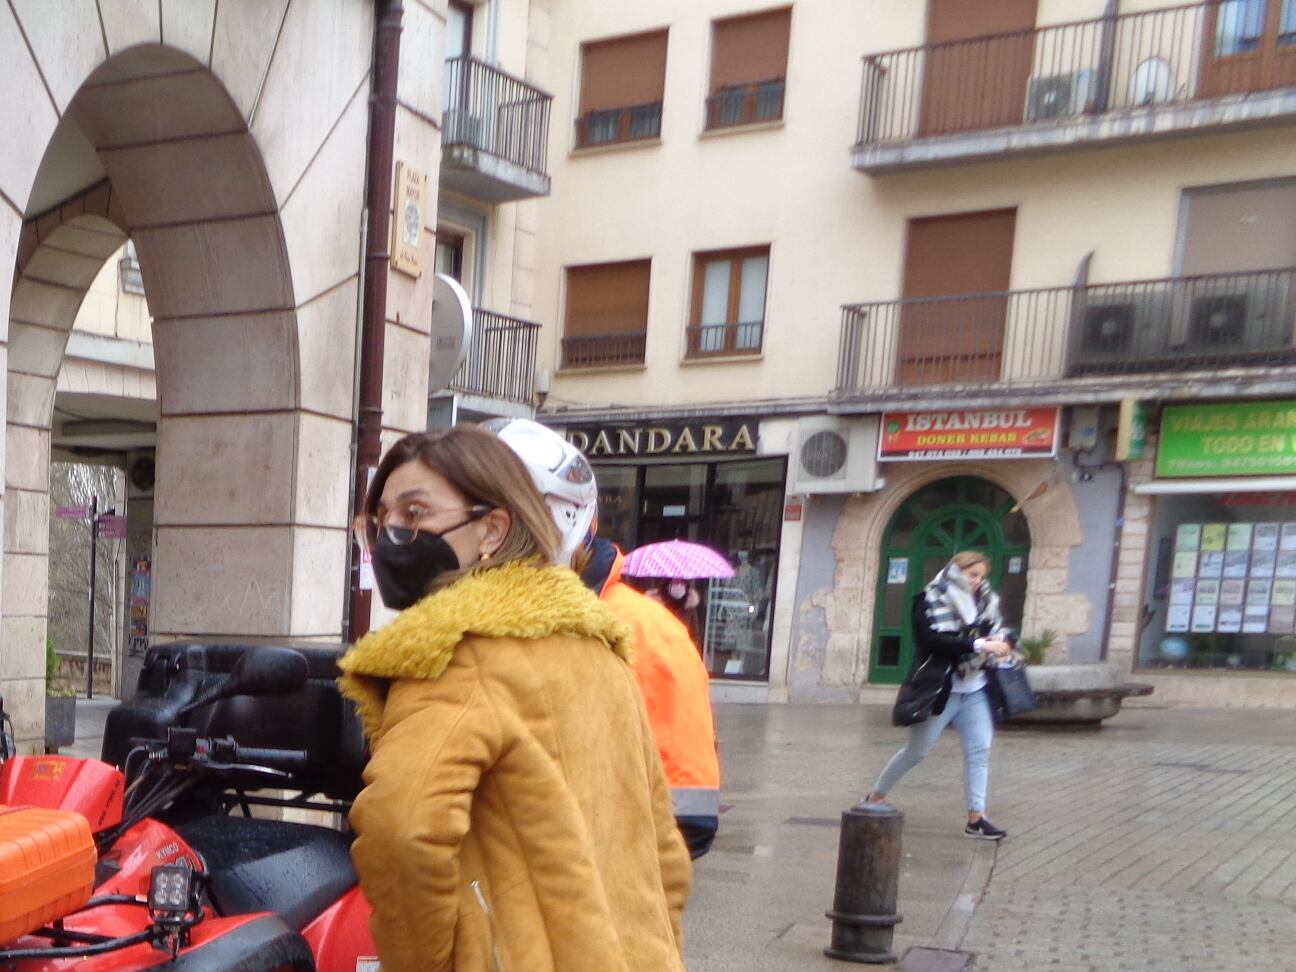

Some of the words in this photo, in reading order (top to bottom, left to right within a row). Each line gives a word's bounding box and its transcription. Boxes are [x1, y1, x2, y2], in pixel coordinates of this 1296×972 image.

[905, 410, 1032, 432] ISTANBUL
[1171, 412, 1238, 433] VIAJES
[566, 423, 756, 455] DANDARA
[917, 433, 965, 446] DONER
[969, 431, 1018, 444] KEBAB
[1202, 435, 1253, 455] TODO
